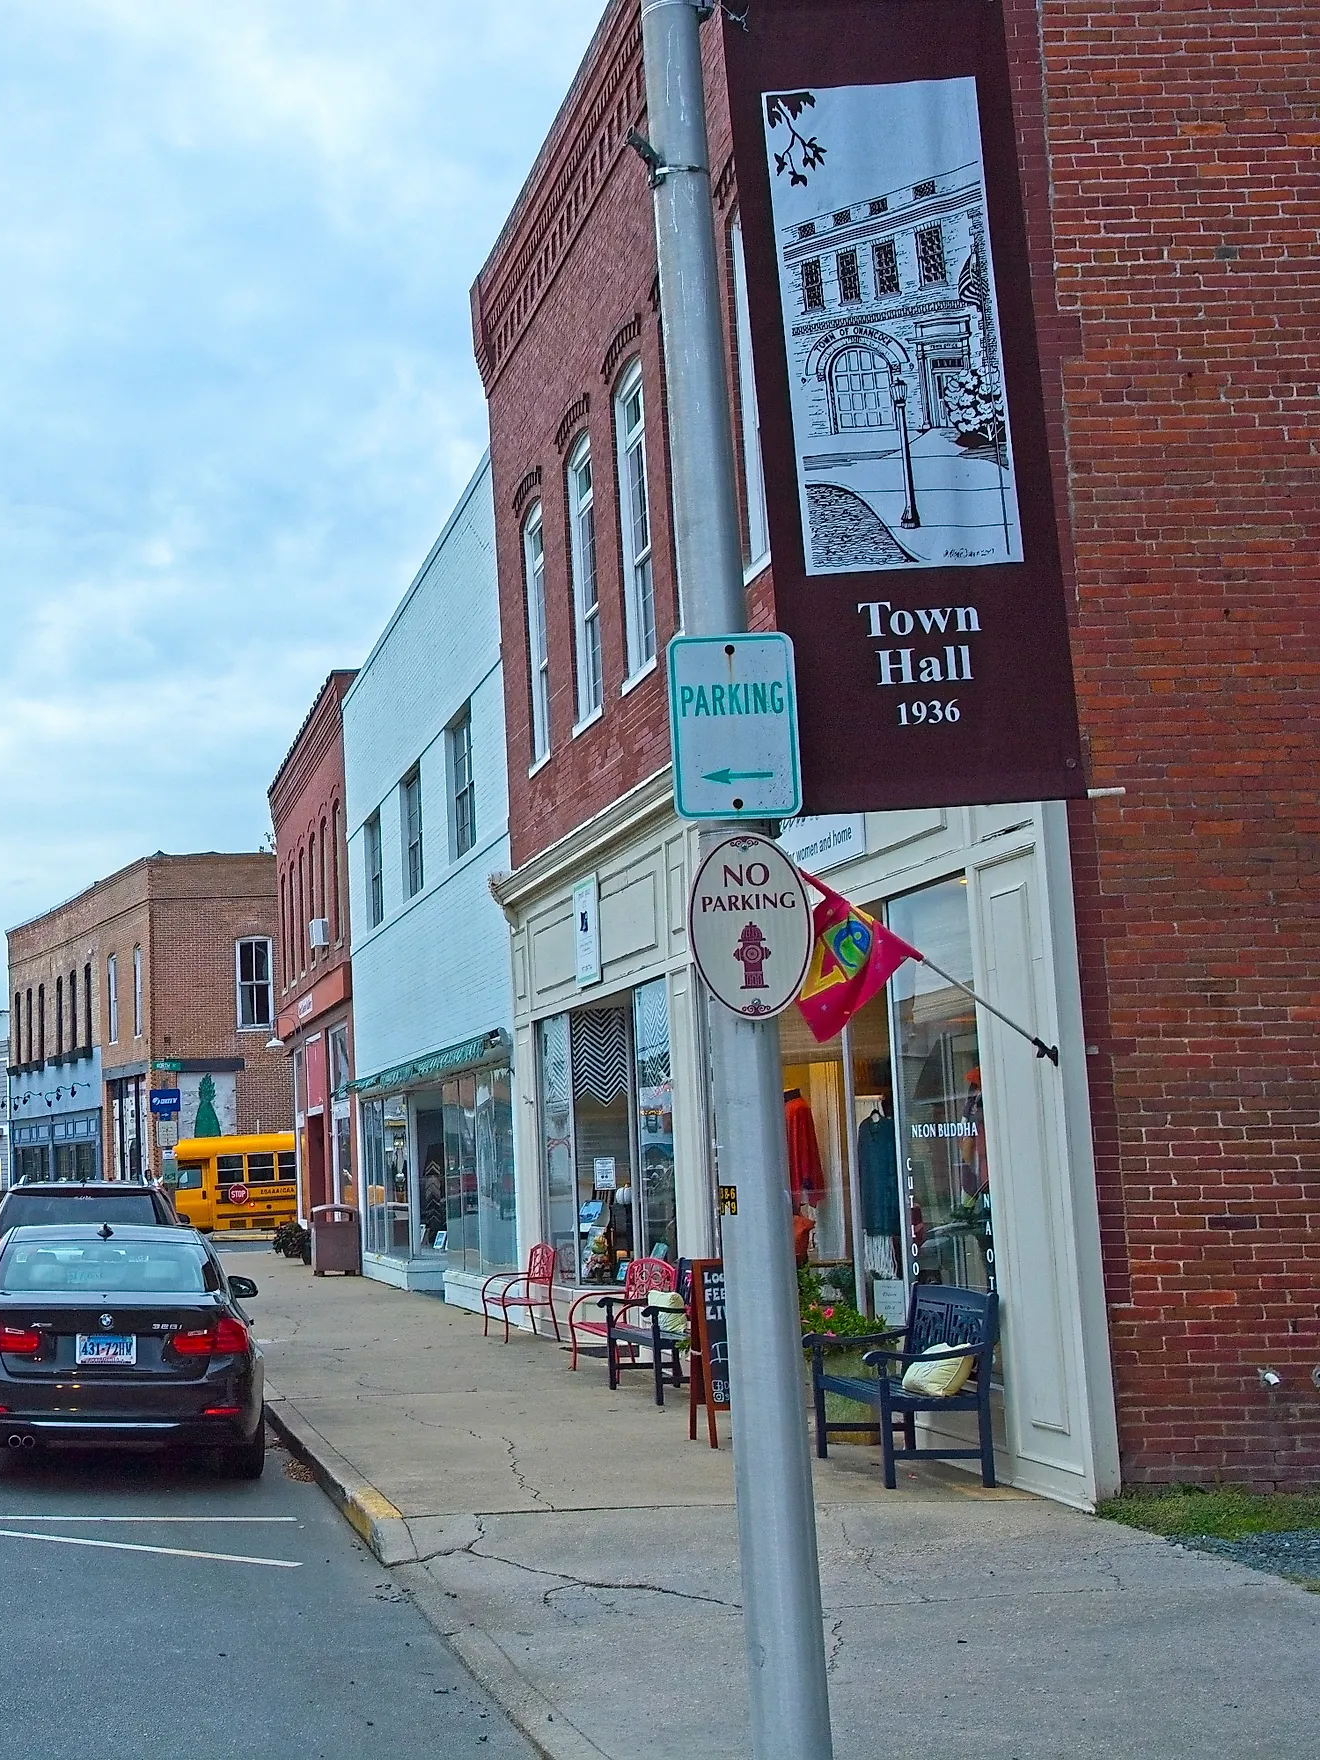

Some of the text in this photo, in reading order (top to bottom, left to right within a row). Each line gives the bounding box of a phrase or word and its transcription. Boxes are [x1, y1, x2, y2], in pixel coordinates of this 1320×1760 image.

[814, 333, 836, 352] TOWN
[840, 327, 849, 336] OF
[857, 601, 982, 638] Town
[874, 645, 975, 686] Hall
[680, 681, 784, 717] PARKING
[896, 699, 961, 726] 1936
[796, 841, 819, 862] women
[819, 832, 832, 853] and
[832, 826, 852, 846] home
[723, 862, 770, 888] NO
[701, 891, 796, 913] PARKING
[911, 1122, 979, 1139] NEON BUDDHA
[230, 1190, 247, 1199] STOP
[982, 1193, 996, 1291] NAOT
